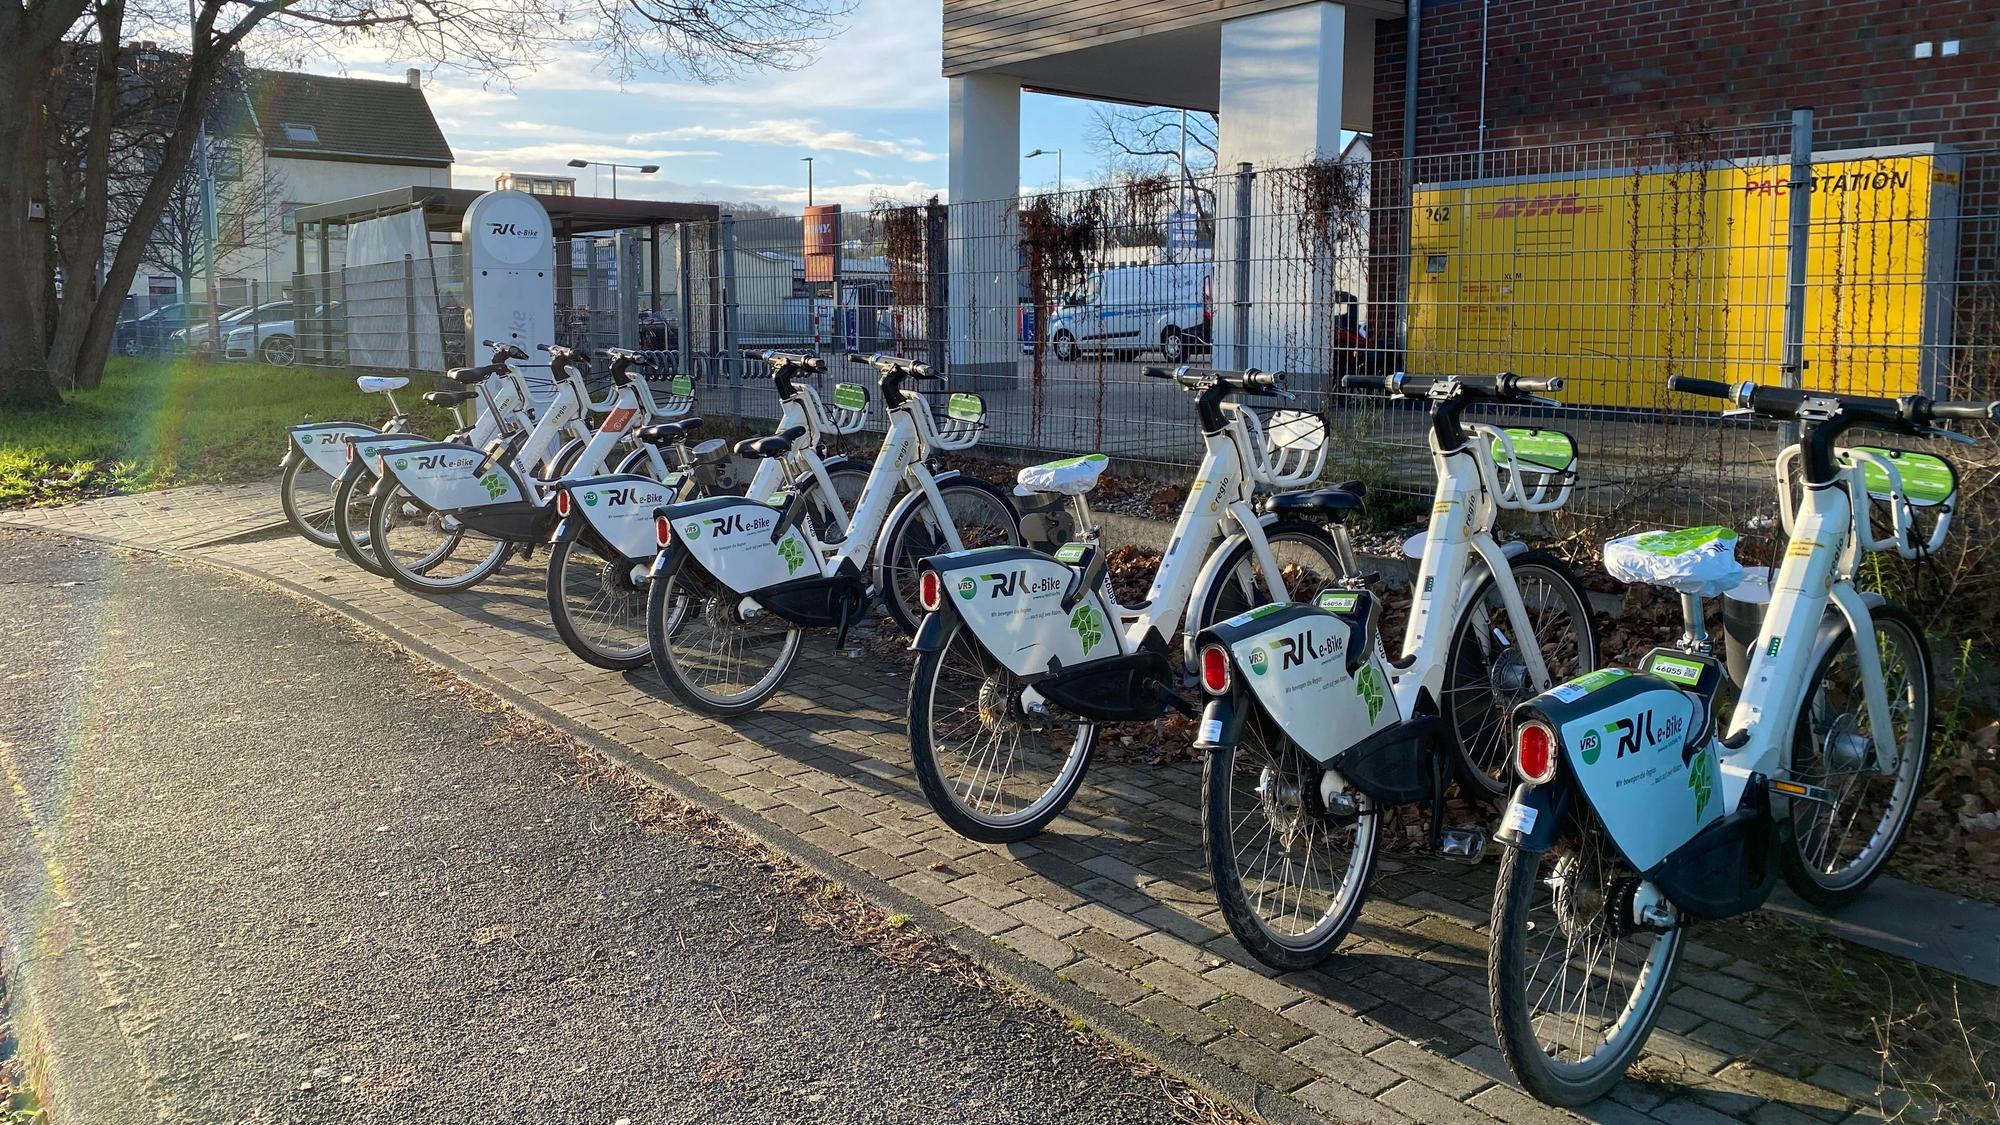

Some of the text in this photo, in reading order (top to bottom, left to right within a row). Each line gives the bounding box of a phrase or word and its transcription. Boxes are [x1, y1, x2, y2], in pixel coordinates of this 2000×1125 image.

[1746, 171, 1909, 198] PACSTATION
[1493, 192, 1586, 219] DHL
[517, 229, 539, 237] e-Bike
[448, 458, 474, 468] e-Bike
[639, 494, 663, 504] e-Bike
[745, 517, 770, 531] e-Bike
[957, 580, 973, 591] VRS
[1031, 577, 1061, 594] e-Bike
[1248, 652, 1263, 665] VRS
[1319, 635, 1343, 657] e-Bike
[1655, 665, 1682, 675] 46055
[1579, 736, 1597, 750] VRS
[1657, 715, 1683, 743] e-Bike
